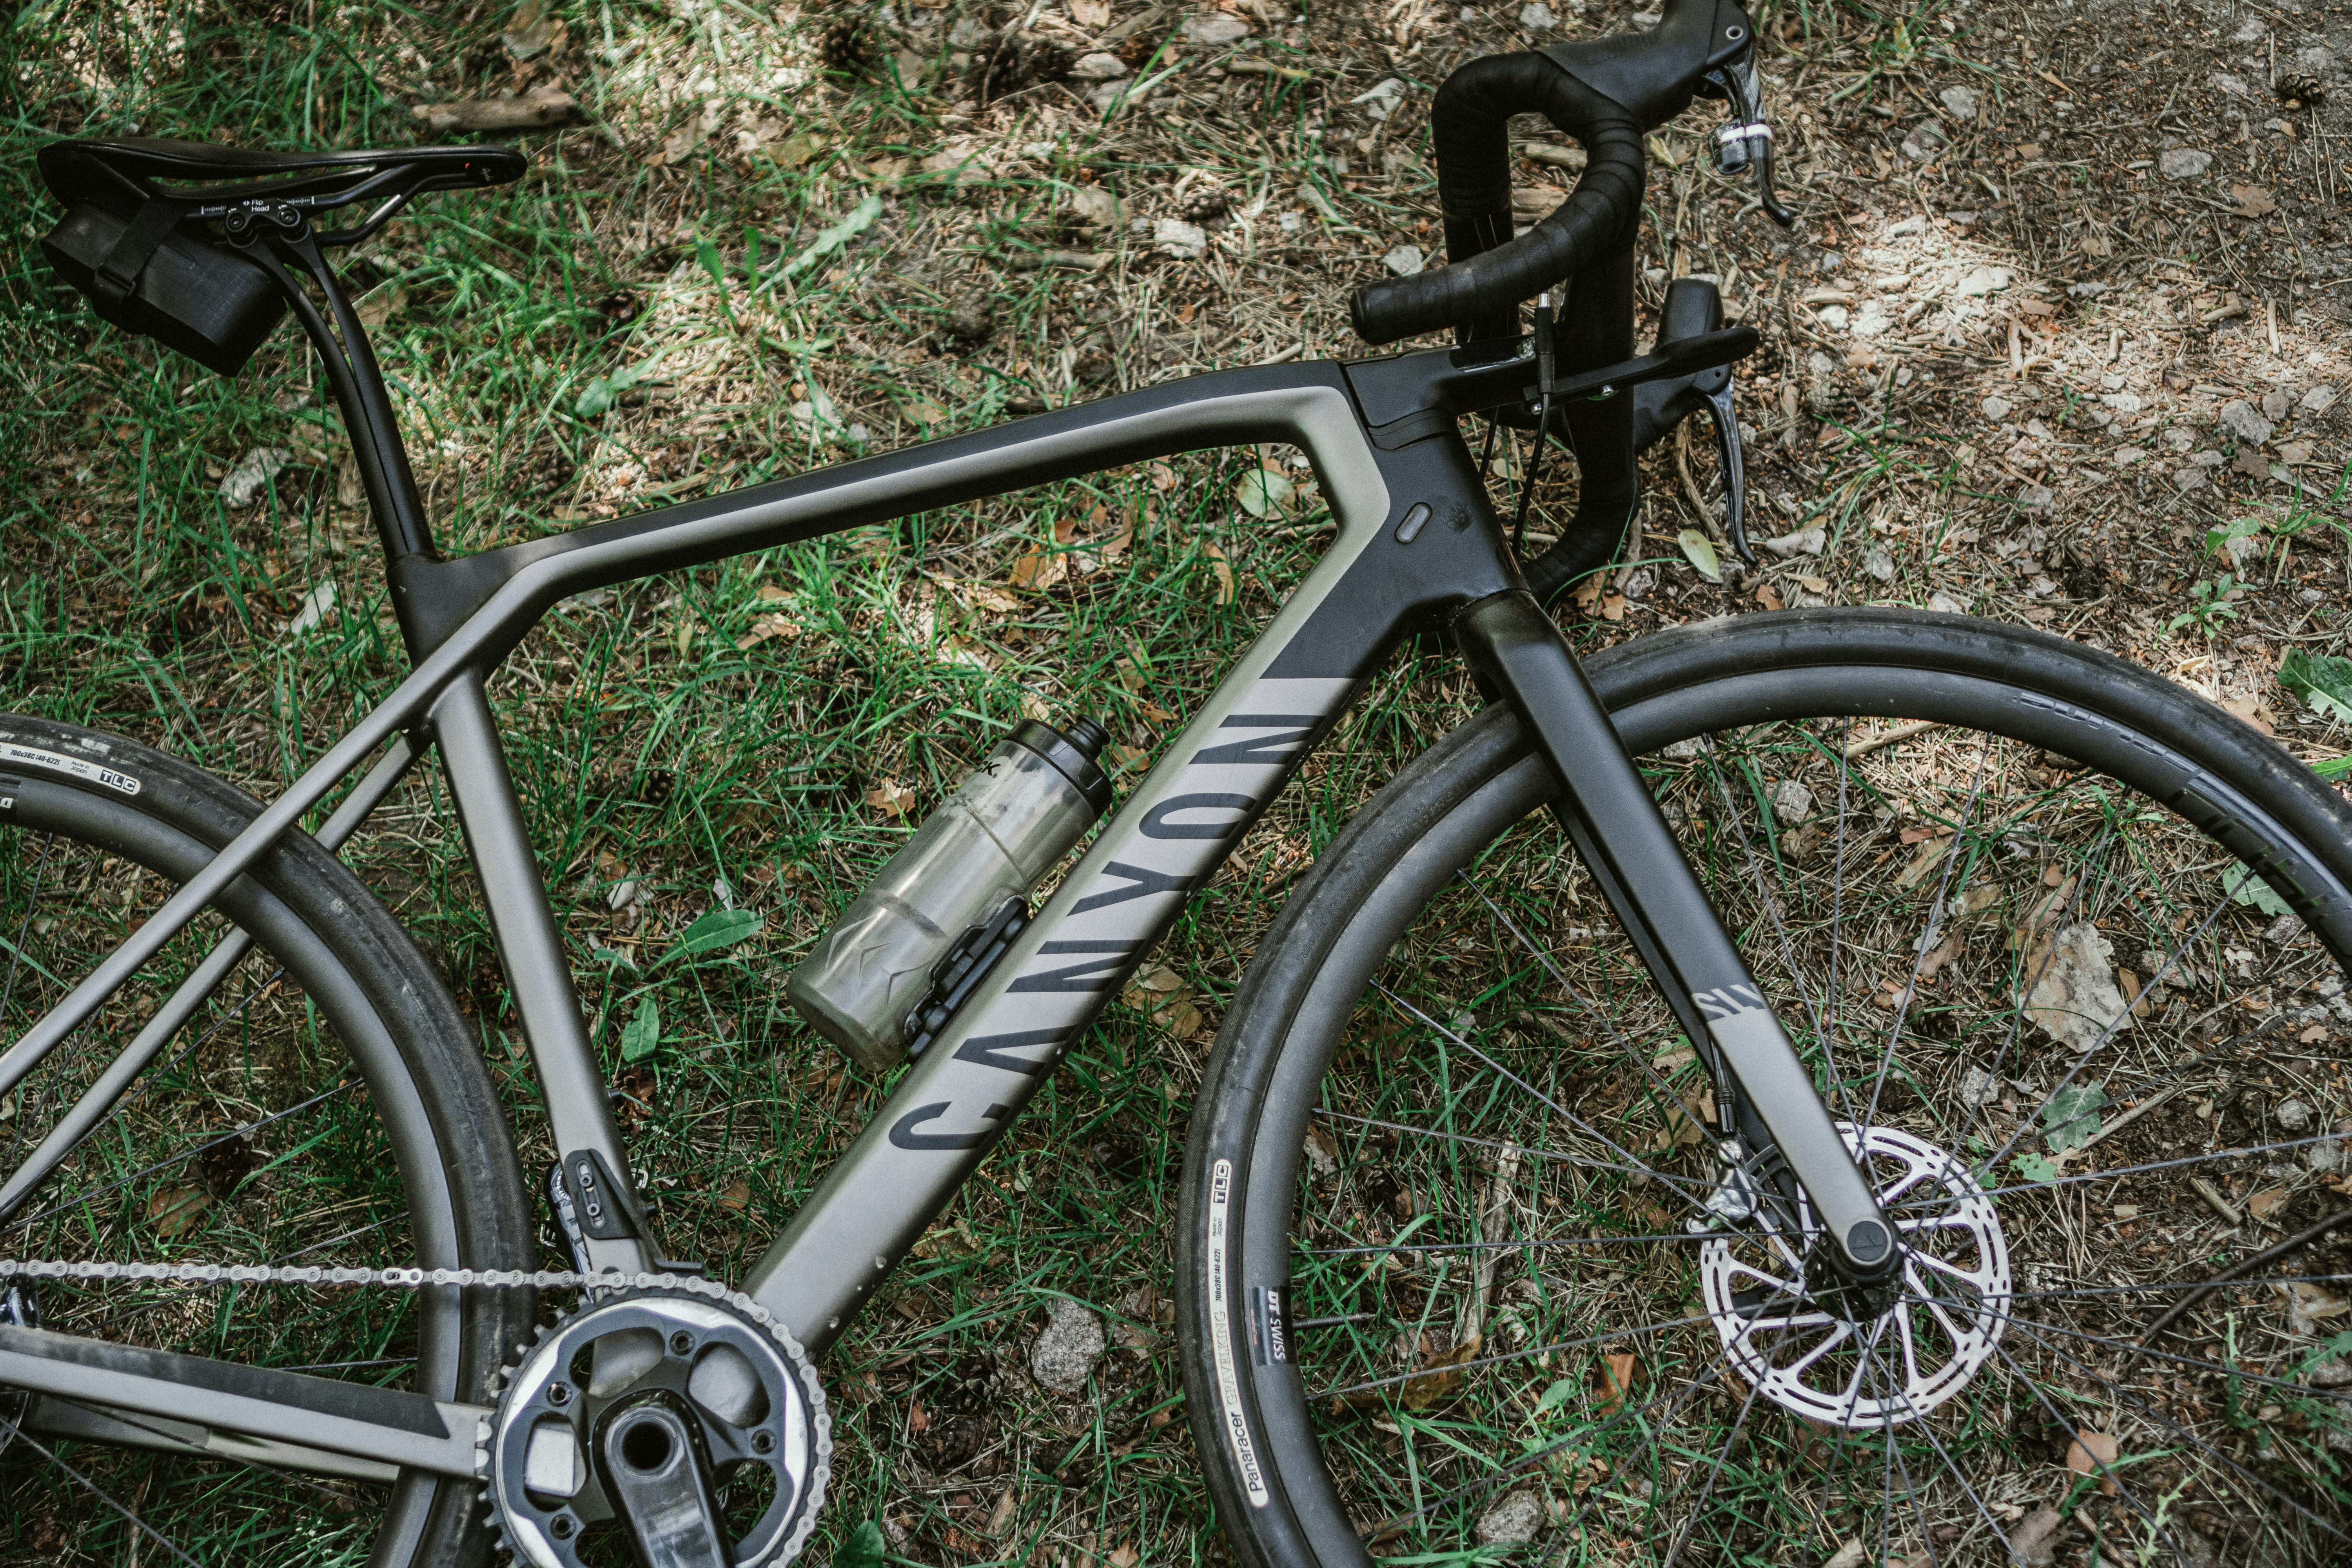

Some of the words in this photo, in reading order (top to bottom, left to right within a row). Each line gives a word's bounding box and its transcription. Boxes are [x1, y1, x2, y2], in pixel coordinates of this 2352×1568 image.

[10, 750, 36, 759] 700x38C
[70, 766, 87, 774] Japan
[100, 769, 136, 792] TLC
[889, 714, 1328, 1151] CANYON
[1296, 929, 1320, 964] Tubed
[1318, 903, 1337, 931] MAX
[1213, 1165, 1229, 1203] TLC
[1268, 1290, 1280, 1315] DT
[1214, 1310, 1237, 1405] GRAVELKING
[1270, 1317, 1286, 1359] SWISS
[1230, 1412, 1263, 1492] Panaracer
